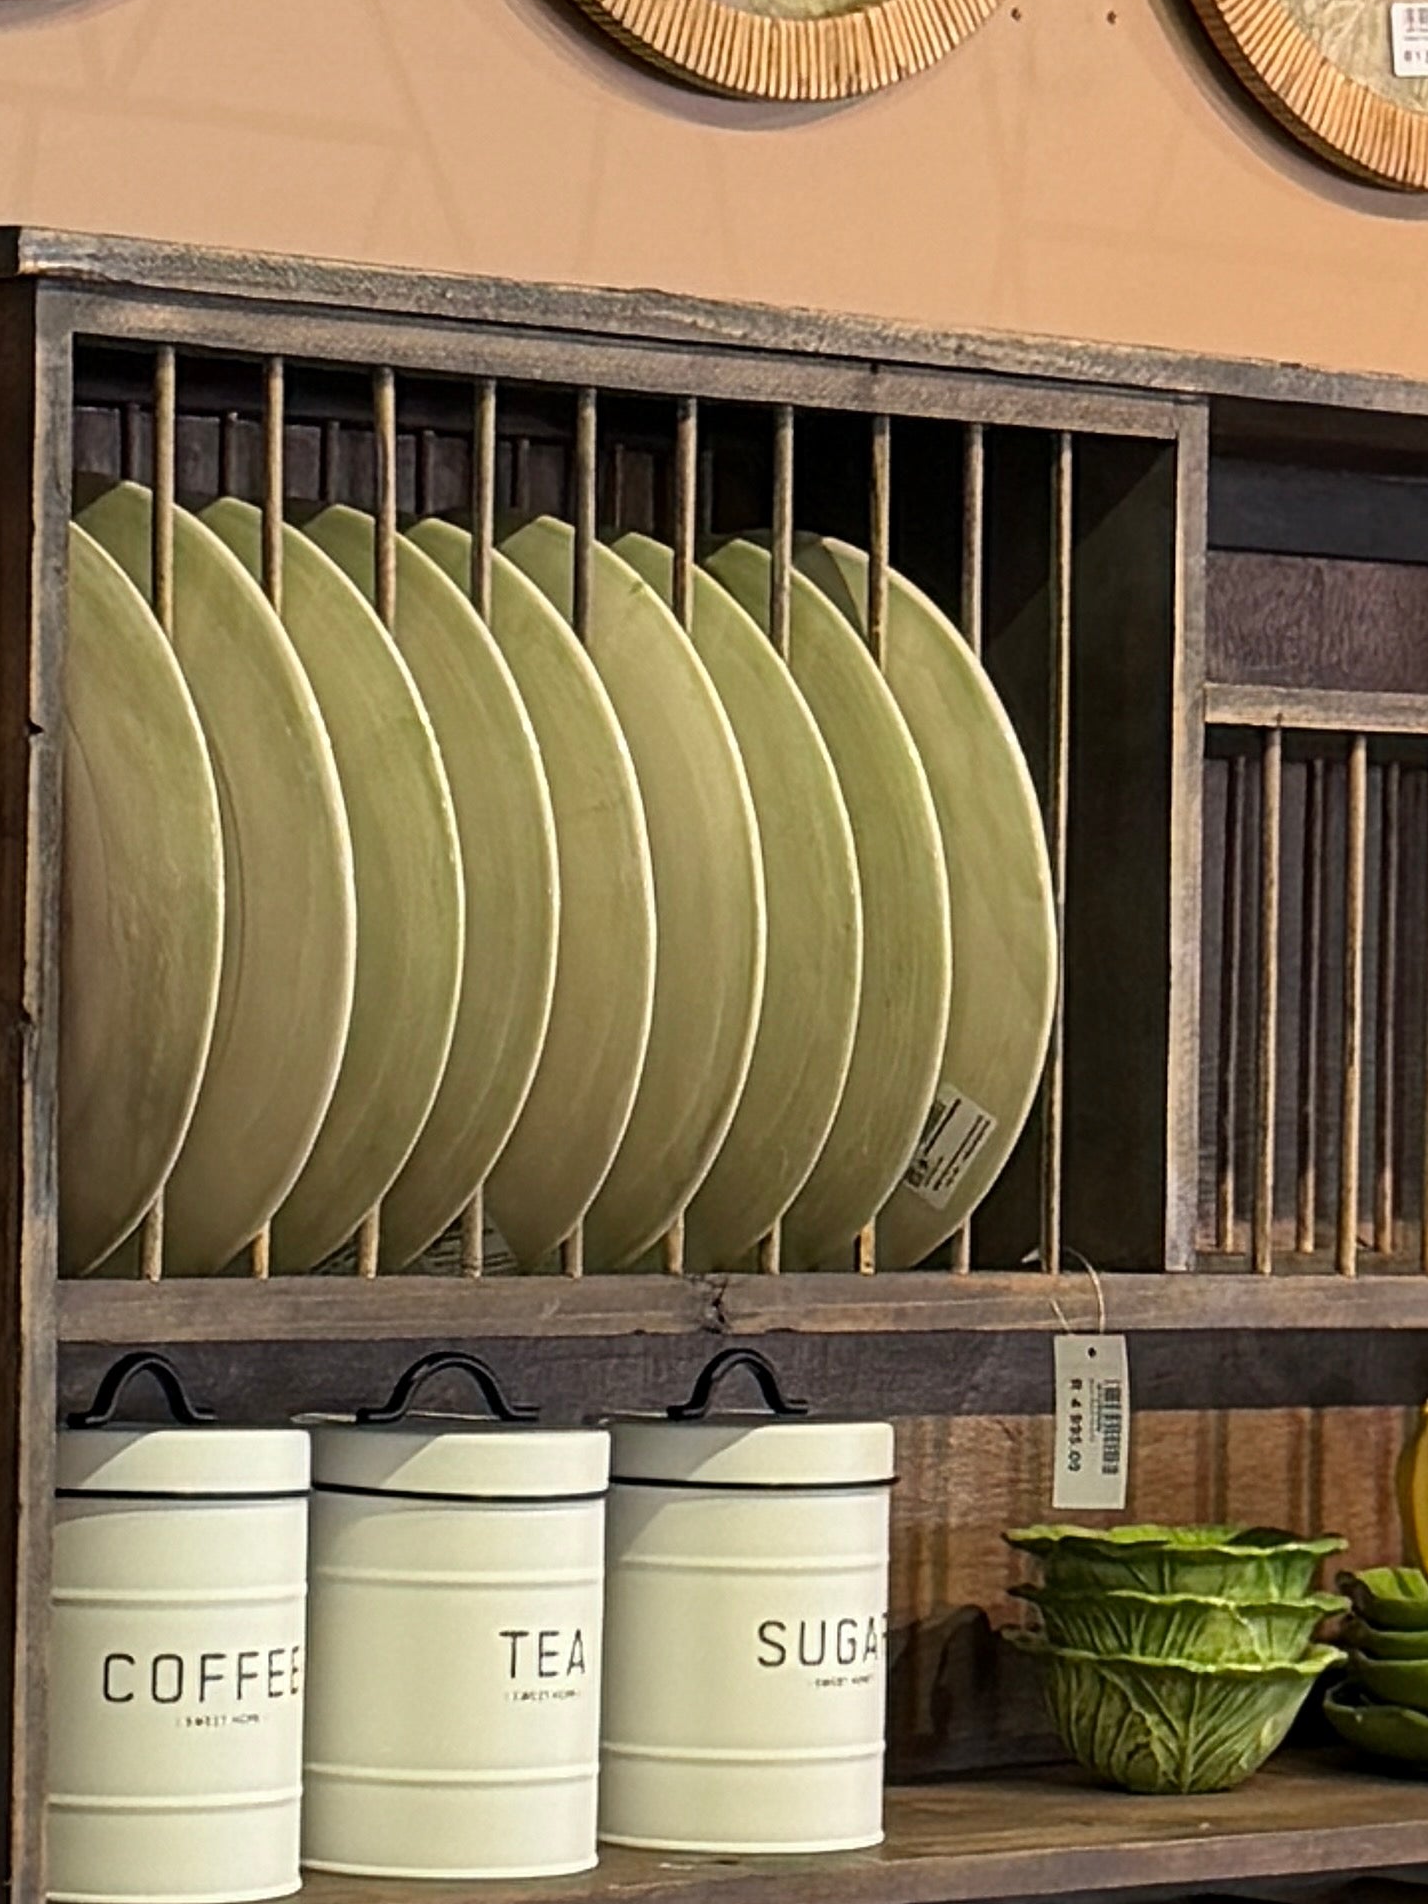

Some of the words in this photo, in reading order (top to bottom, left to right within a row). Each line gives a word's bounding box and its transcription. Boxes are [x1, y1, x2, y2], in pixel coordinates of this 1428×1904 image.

[498, 1628, 586, 1680] TEA
[756, 1612, 888, 1668] SUGA
[102, 1646, 300, 1705] COFFEE
